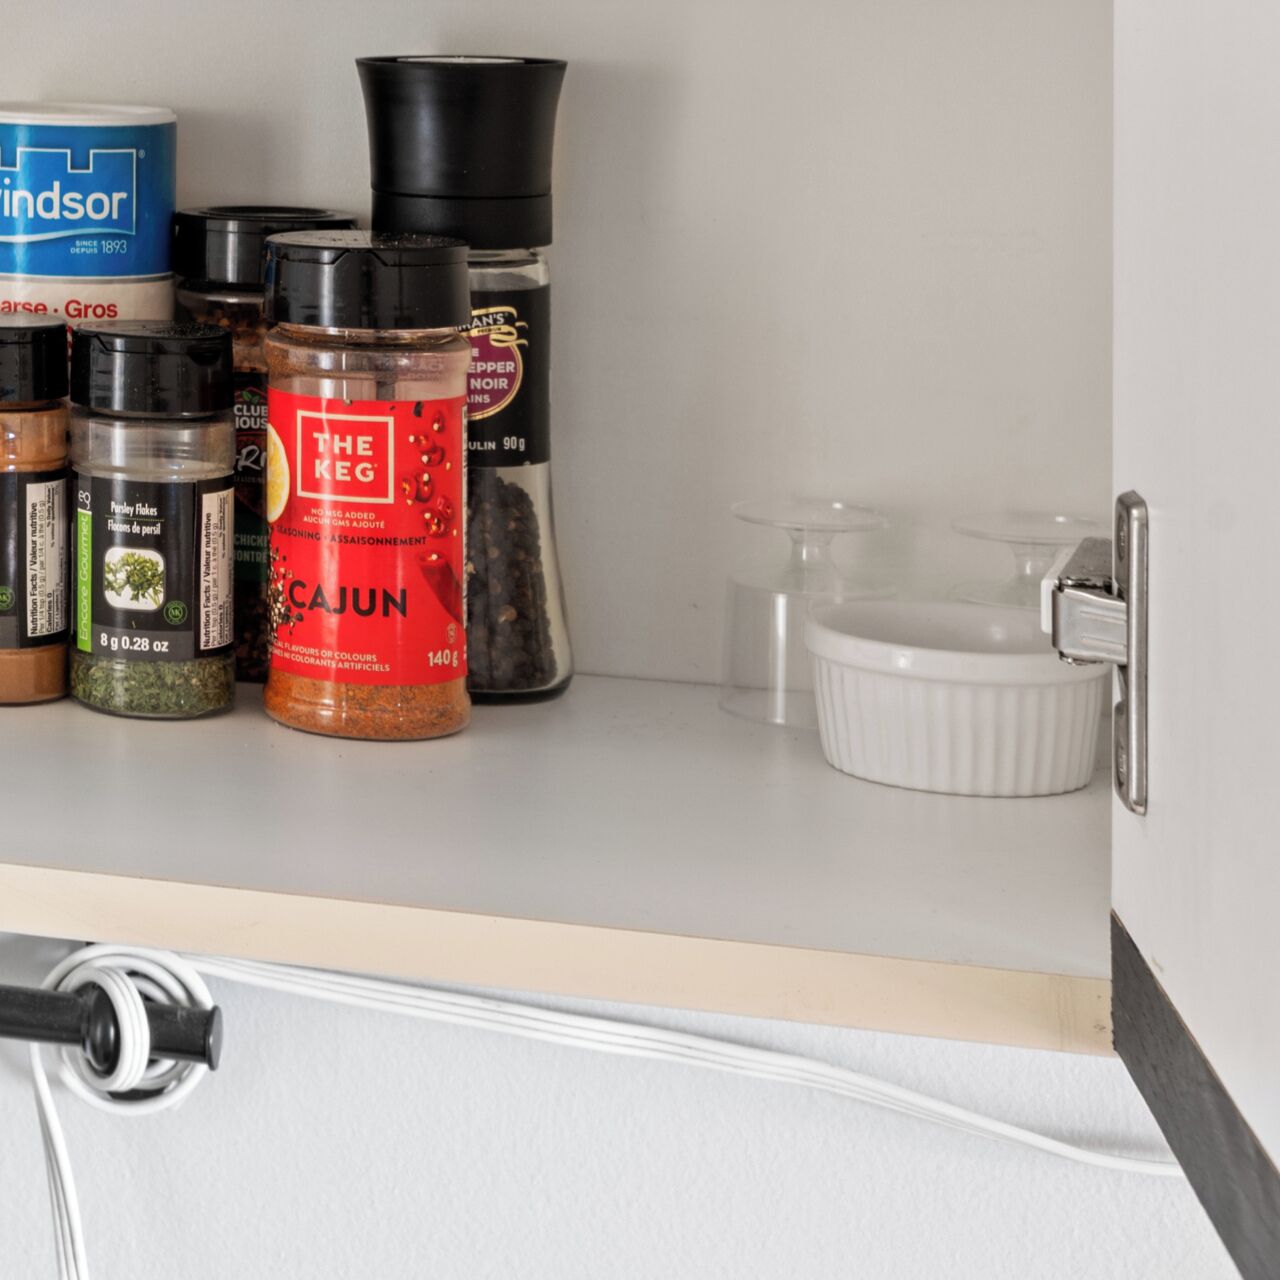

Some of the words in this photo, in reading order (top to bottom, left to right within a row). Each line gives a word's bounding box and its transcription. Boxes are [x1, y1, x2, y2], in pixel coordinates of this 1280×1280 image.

[101, 239, 127, 254] 1893
[64, 300, 118, 319] Gros
[468, 362, 515, 373] EPPER
[471, 378, 508, 390] NOIR
[313, 432, 373, 456] THE
[314, 459, 375, 483] KEG
[111, 502, 134, 517] Parsley
[136, 503, 157, 516] Flakes
[311, 508, 323, 516] NO
[345, 511, 375, 520] ADDED
[108, 521, 131, 533] Flocons
[132, 522, 140, 534] de
[142, 523, 161, 536] persil
[303, 515, 331, 525] AUCUN
[332, 519, 350, 528] GMS
[352, 520, 385, 529] AJOUTÉ
[277, 524, 321, 541] SEASONING
[330, 535, 427, 546] ASSAISONNEMENT
[80, 514, 89, 581] Gourmet
[288, 580, 407, 618] CAJUN
[80, 586, 88, 640] Encore
[101, 633, 108, 646] 8
[111, 638, 118, 650] g
[121, 637, 149, 650] 0.28
[153, 640, 168, 652] oz
[285, 643, 320, 657] FLAVOURS
[321, 649, 333, 658] OR
[334, 652, 377, 662] COLOURS
[428, 649, 450, 667] 140
[291, 654, 336, 668] COLORANTS
[338, 661, 391, 672] ARTIFICIELS
